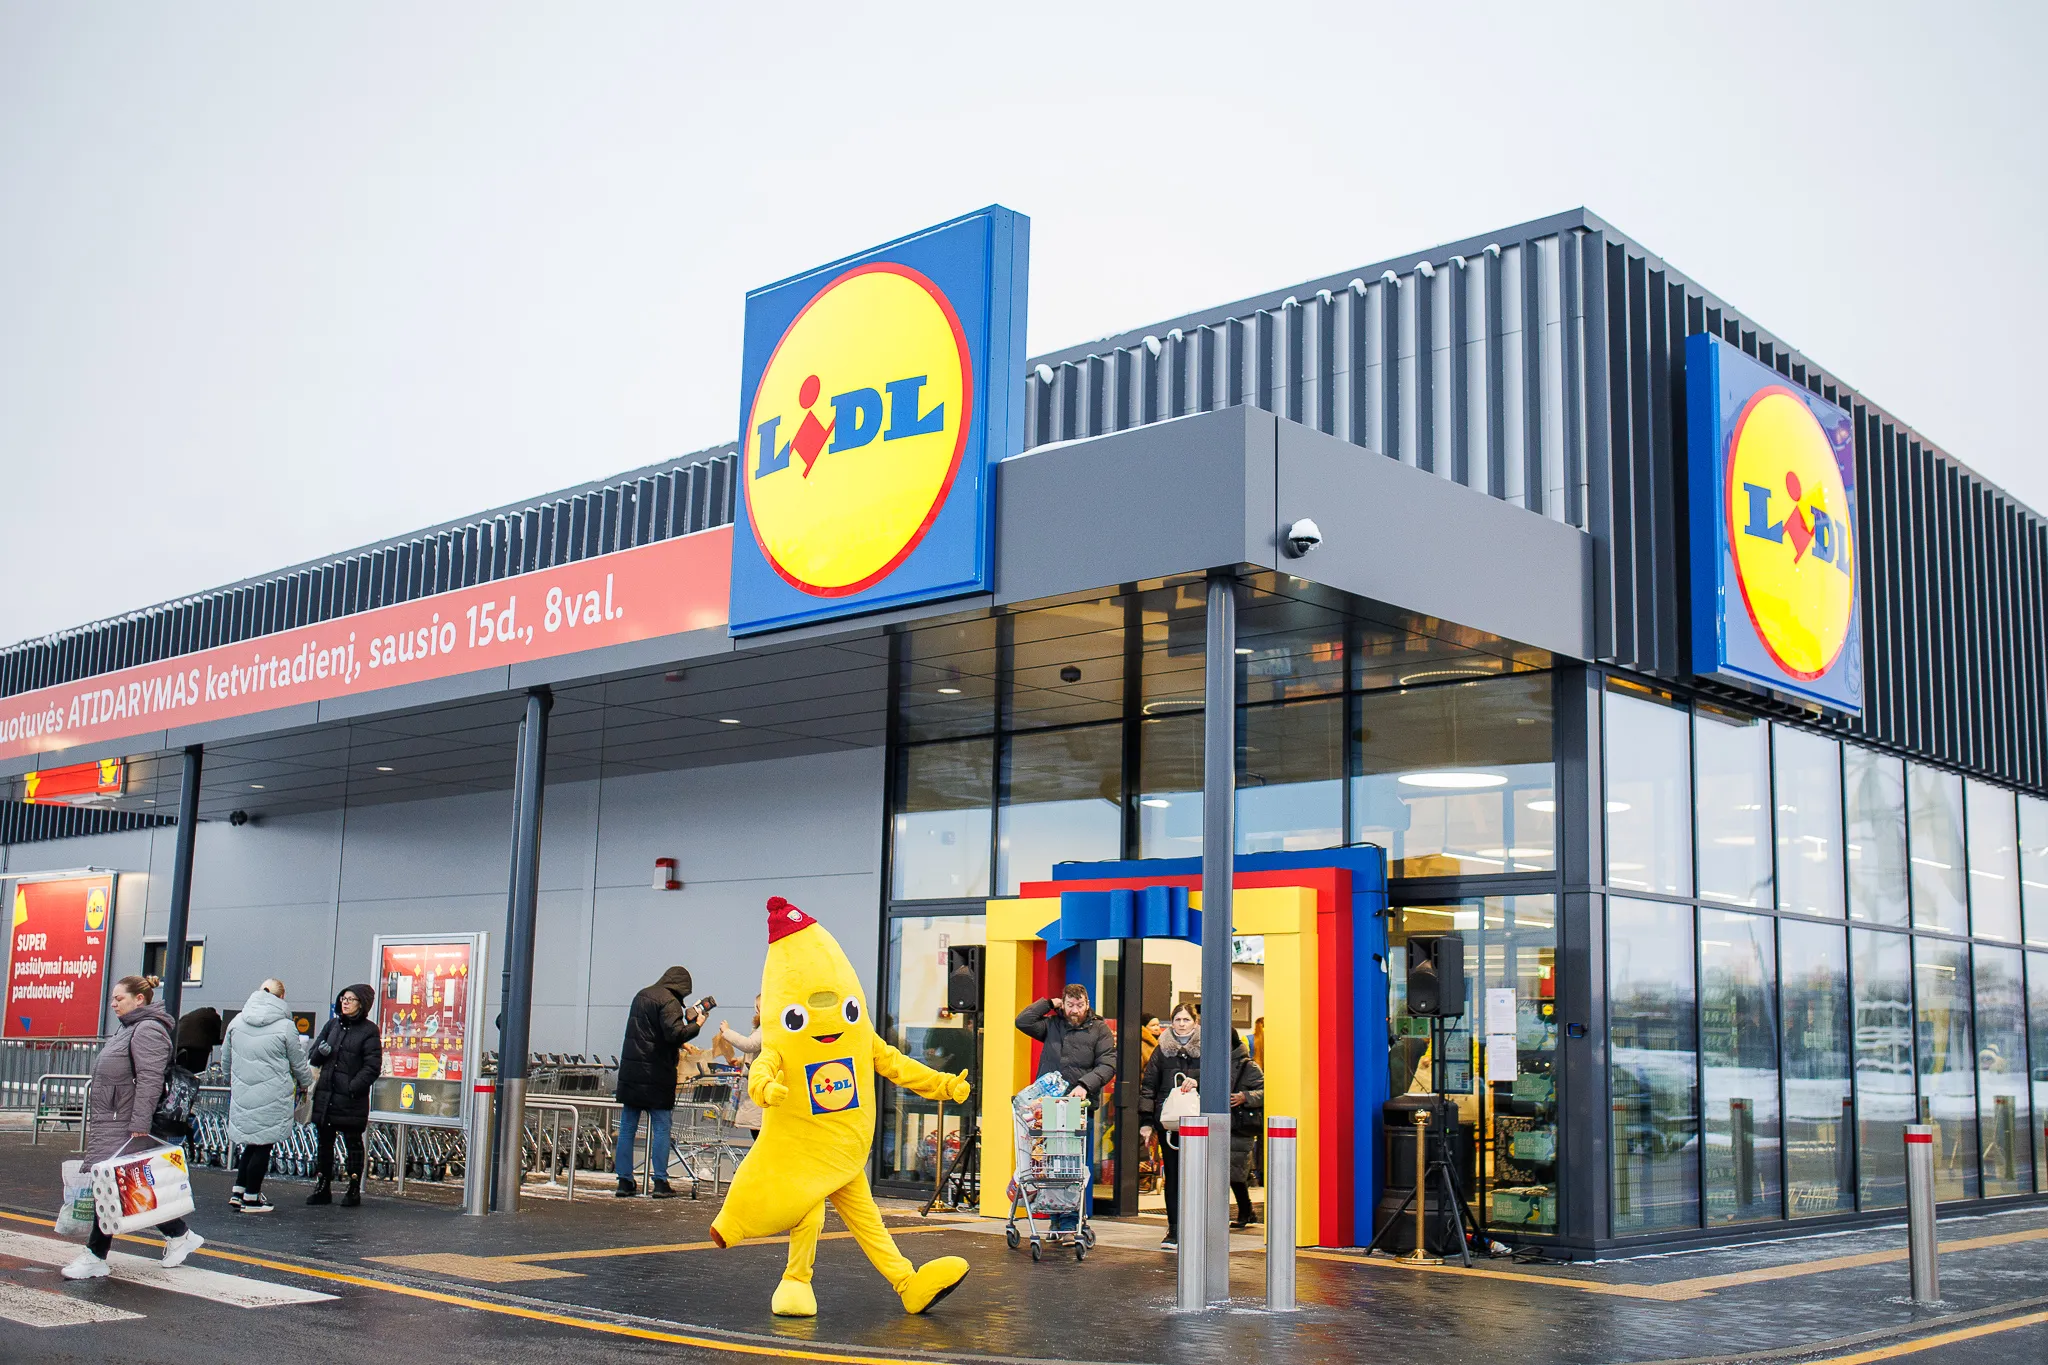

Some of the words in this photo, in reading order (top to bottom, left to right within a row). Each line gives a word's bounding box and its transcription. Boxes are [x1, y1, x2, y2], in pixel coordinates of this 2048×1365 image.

[67, 668, 200, 730] ATIDARYMAS
[204, 632, 361, 702] ketvirtadienį,
[368, 613, 456, 668] sausio
[466, 595, 534, 648] 15d.,
[543, 573, 623, 632] 8val.
[17, 933, 47, 951] SUPER
[63, 955, 97, 978] naujoje
[12, 981, 74, 1003] parduotuvėje!
